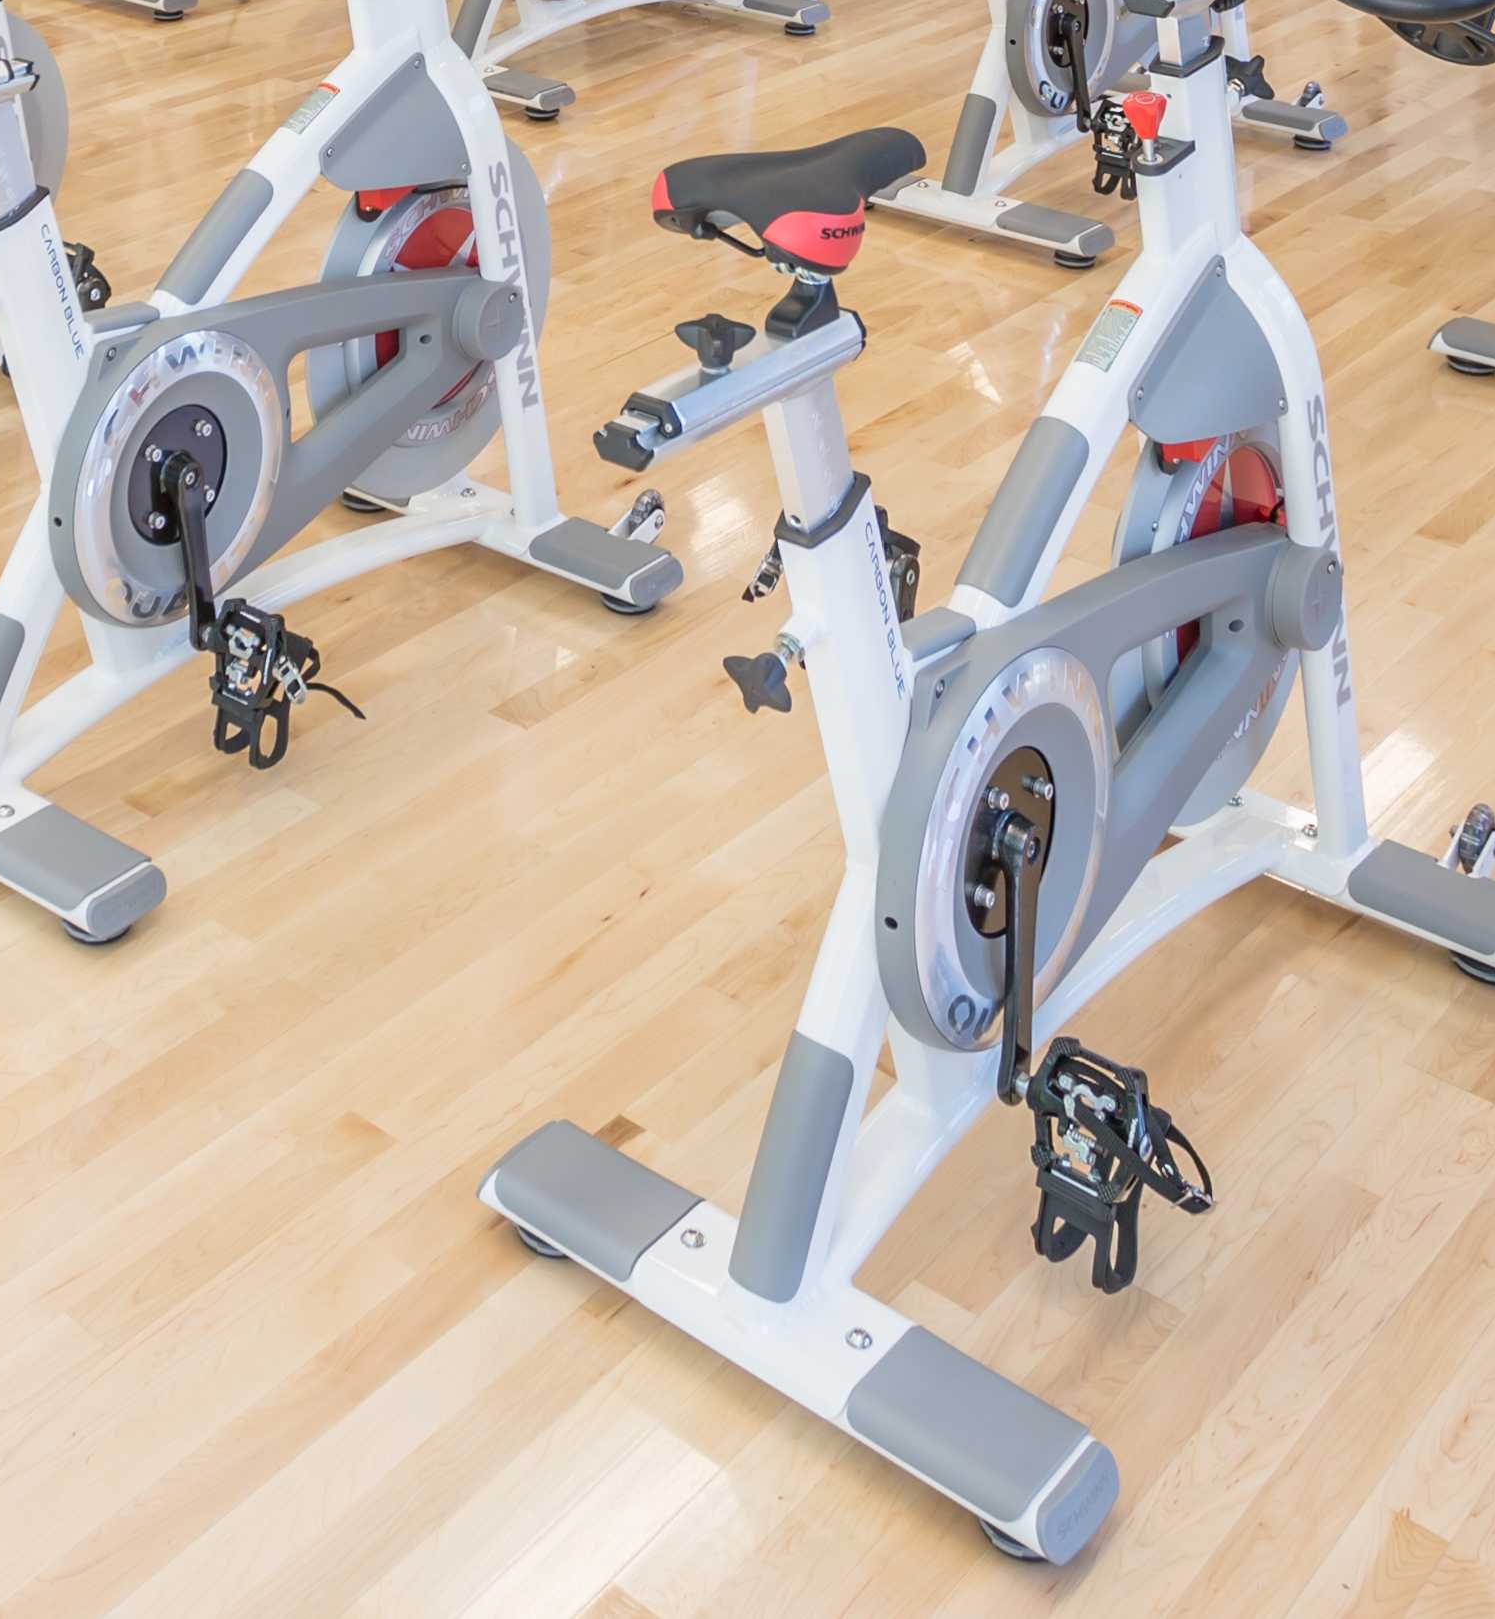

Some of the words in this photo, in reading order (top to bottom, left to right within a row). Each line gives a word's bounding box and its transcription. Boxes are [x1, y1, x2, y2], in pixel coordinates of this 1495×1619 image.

[40, 223, 69, 304] CARBON
[63, 304, 85, 360] BLUE
[865, 521, 890, 626] CARBON
[886, 626, 907, 701] BLUE
